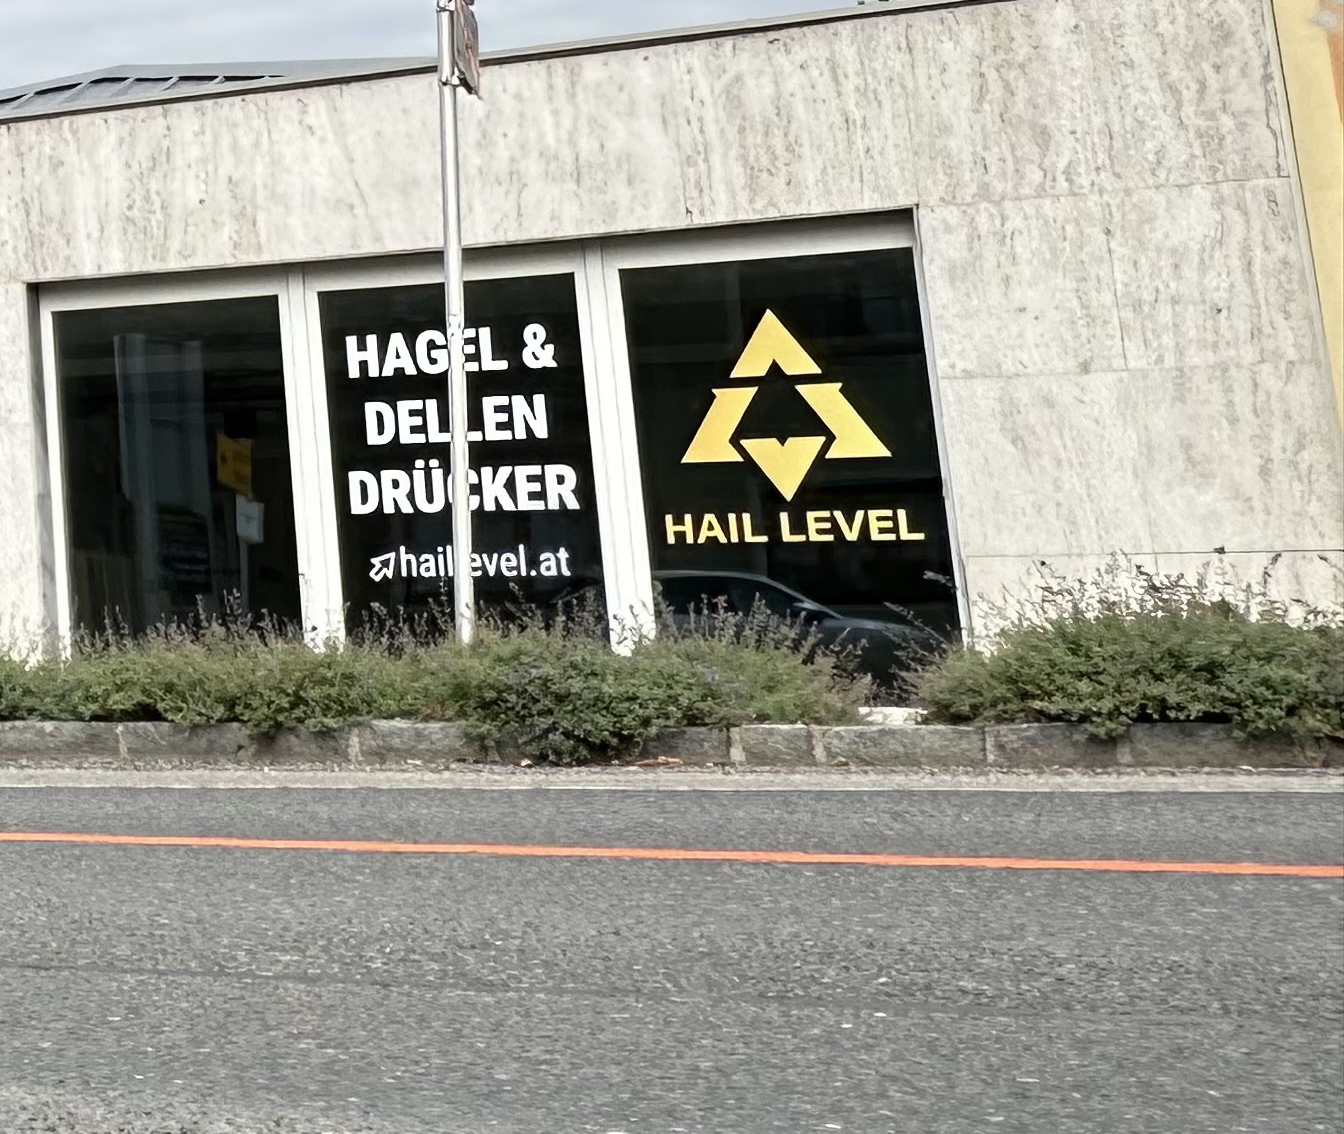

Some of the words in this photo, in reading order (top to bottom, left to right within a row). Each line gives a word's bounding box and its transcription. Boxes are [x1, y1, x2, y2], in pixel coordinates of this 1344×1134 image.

[345, 326, 509, 379] HAGEL
[521, 322, 558, 369] &
[364, 393, 549, 446] DELEN
[664, 512, 768, 545] HAIL
[779, 509, 926, 543] LEVEL
[399, 543, 572, 577] hailevel.at
